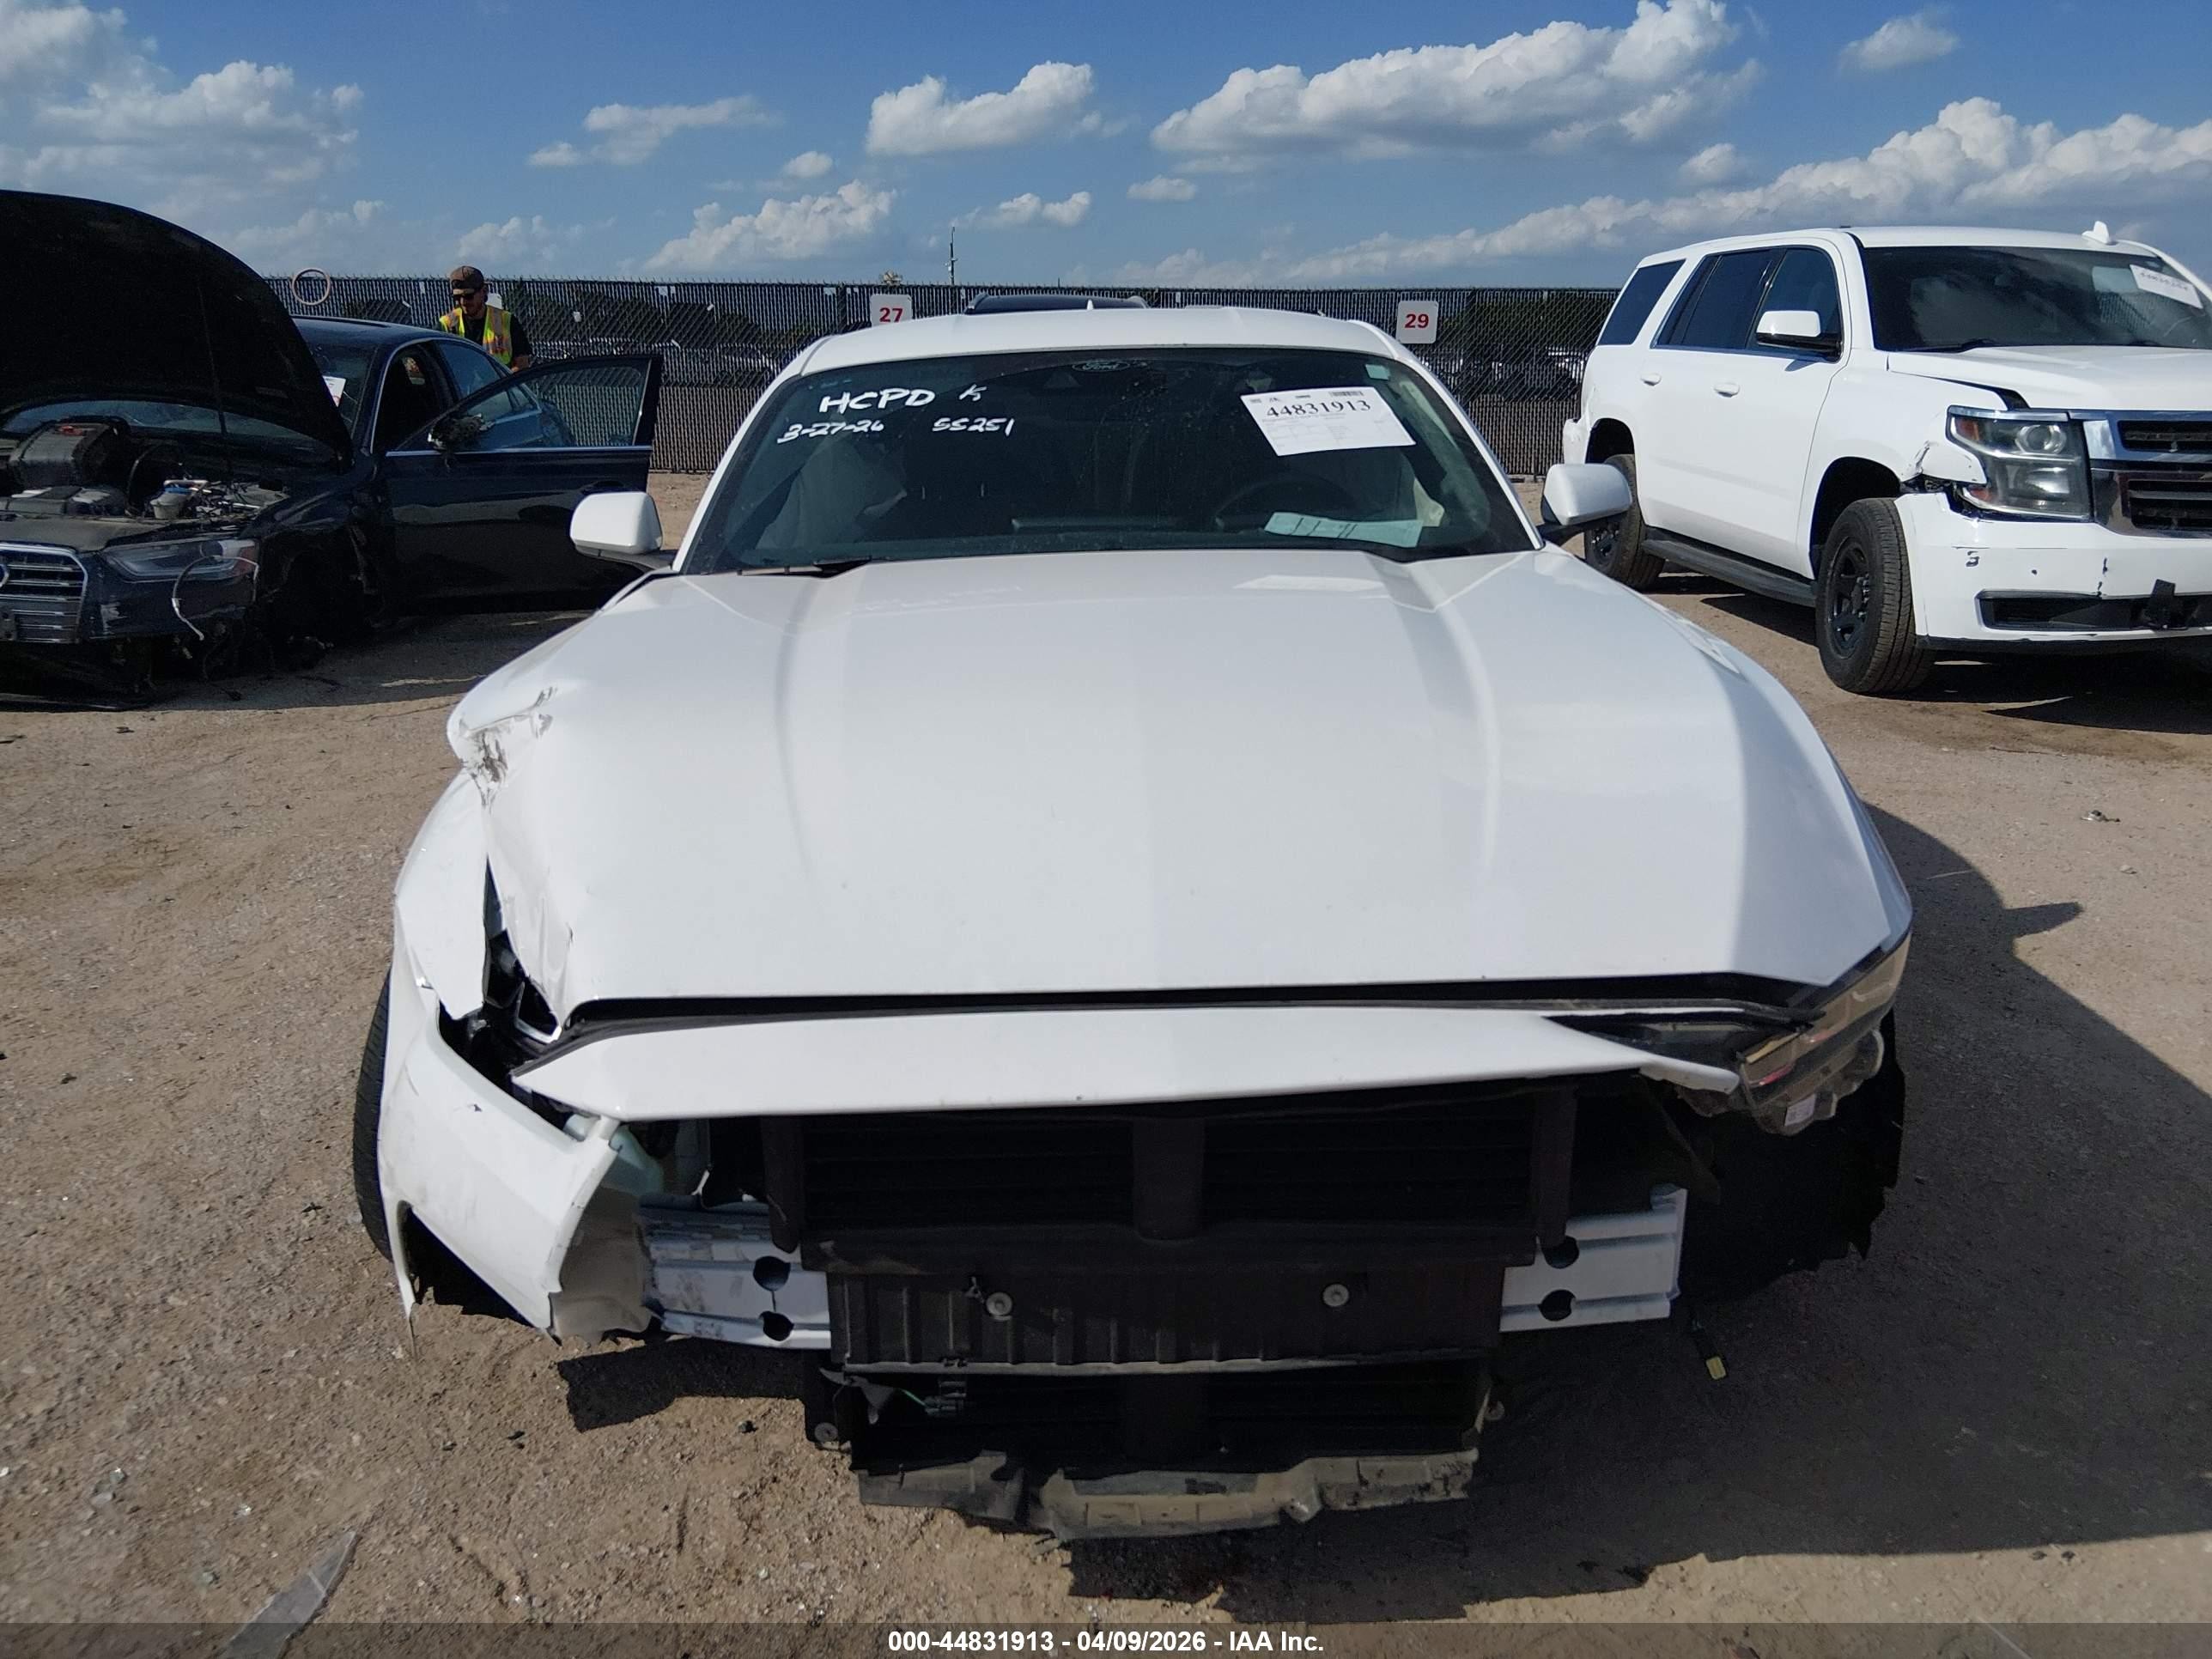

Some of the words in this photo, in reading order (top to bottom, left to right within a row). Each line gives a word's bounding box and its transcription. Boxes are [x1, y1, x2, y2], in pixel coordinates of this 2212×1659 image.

[879, 307, 903, 323] 27
[1404, 313, 1430, 329] 29
[818, 387, 936, 414] HCPD
[1267, 399, 1371, 417] 44831913
